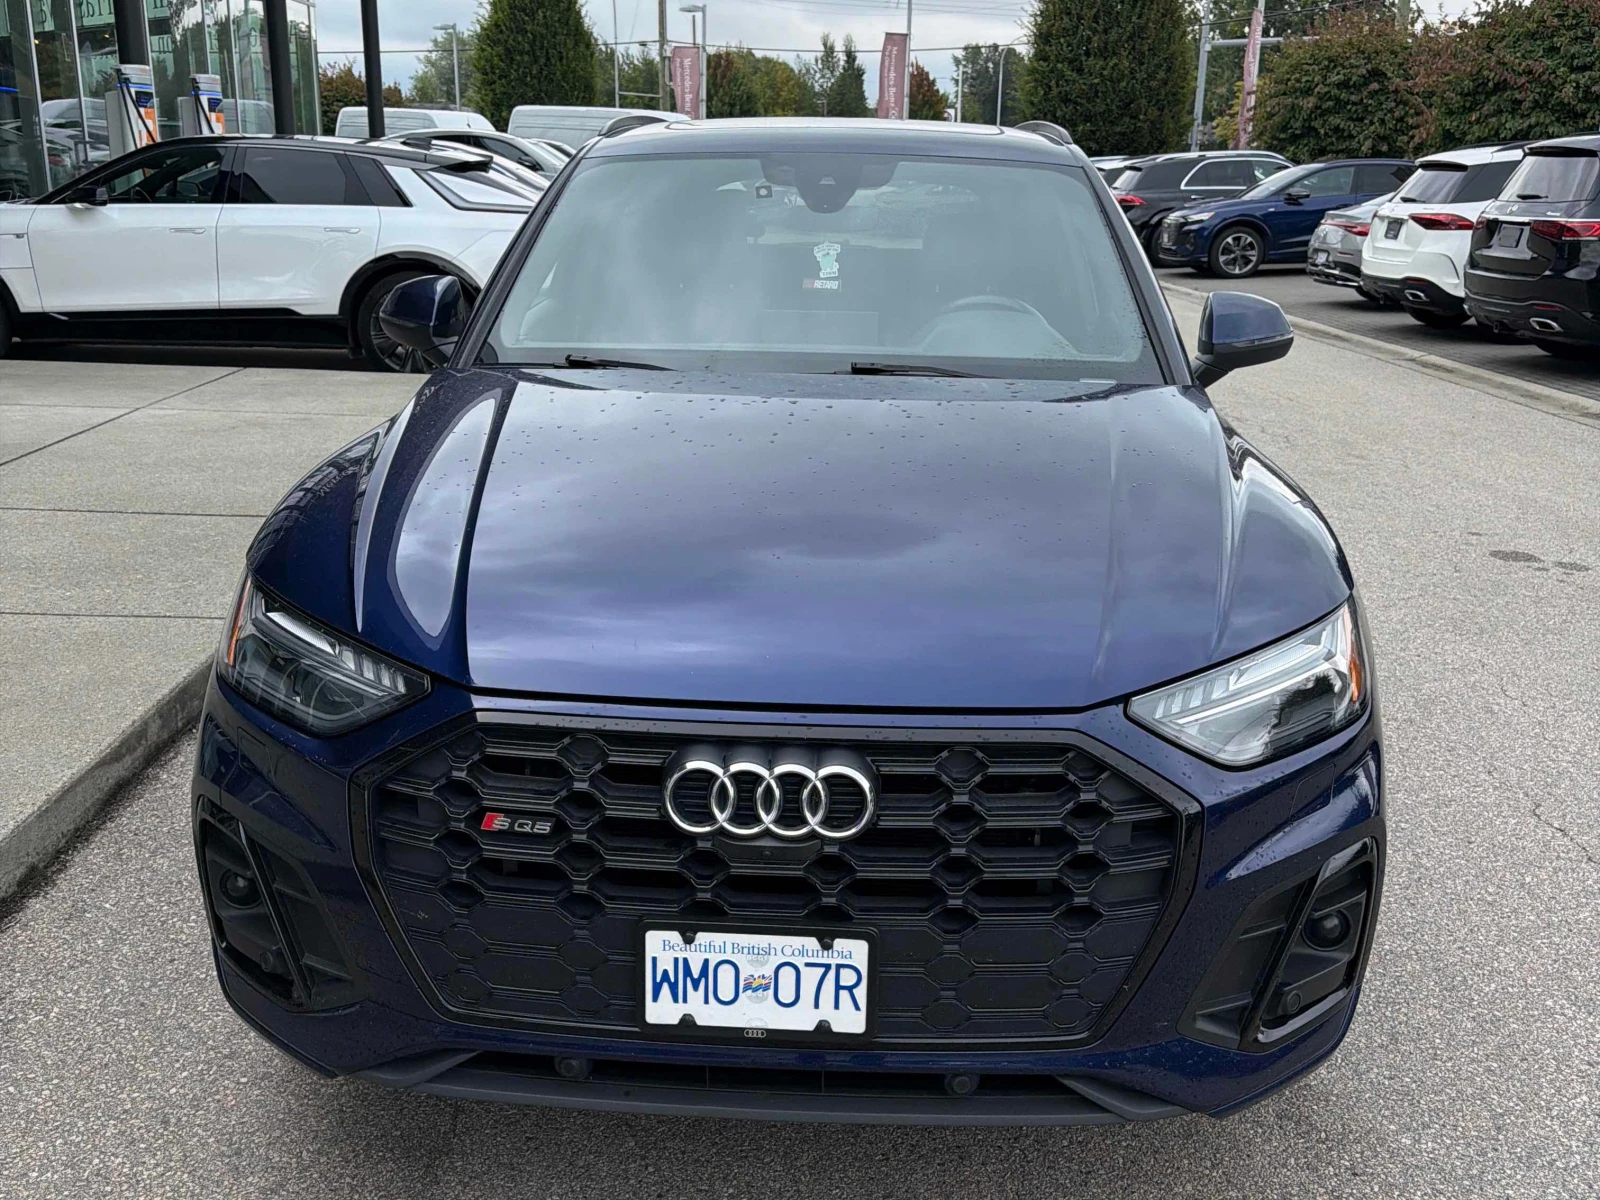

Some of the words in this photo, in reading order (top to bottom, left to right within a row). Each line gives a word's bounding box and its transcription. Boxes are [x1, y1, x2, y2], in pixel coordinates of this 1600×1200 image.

[662, 939, 727, 955] Beautiful
[731, 942, 777, 957] British
[780, 944, 853, 960] Columbia
